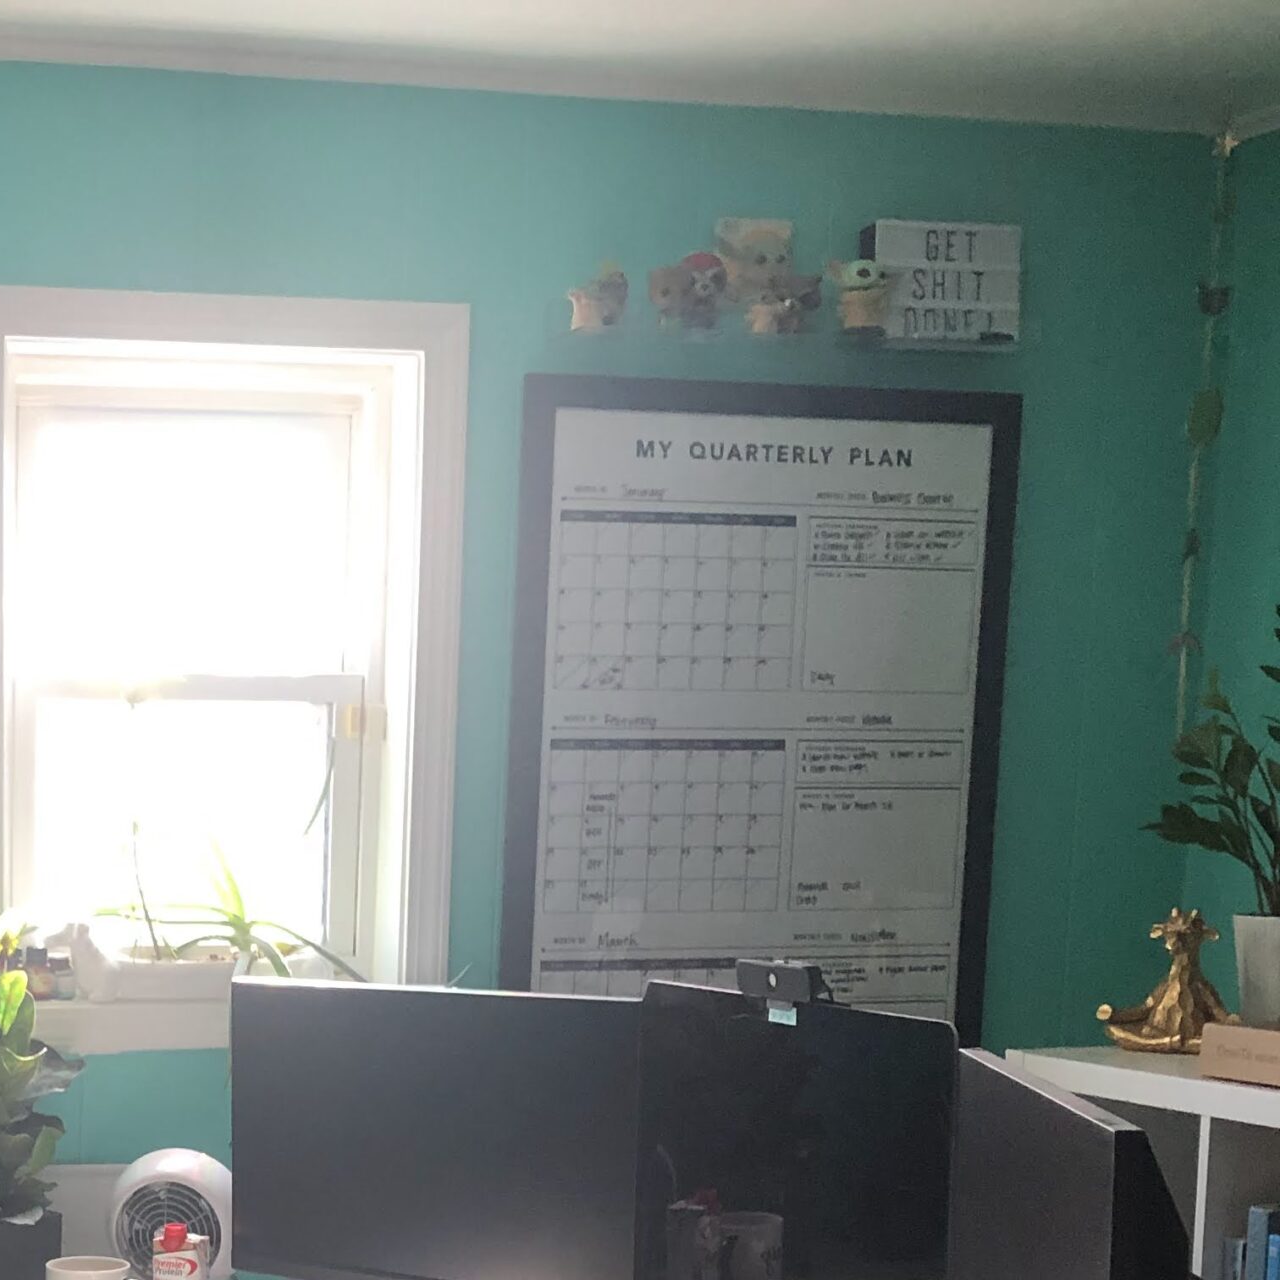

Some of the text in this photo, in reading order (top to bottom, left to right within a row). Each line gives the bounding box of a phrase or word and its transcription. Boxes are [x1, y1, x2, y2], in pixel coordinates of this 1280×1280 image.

[925, 229, 977, 263] GET
[912, 268, 984, 302] SHIT
[635, 439, 913, 468] MY QUARTERLY PLAN
